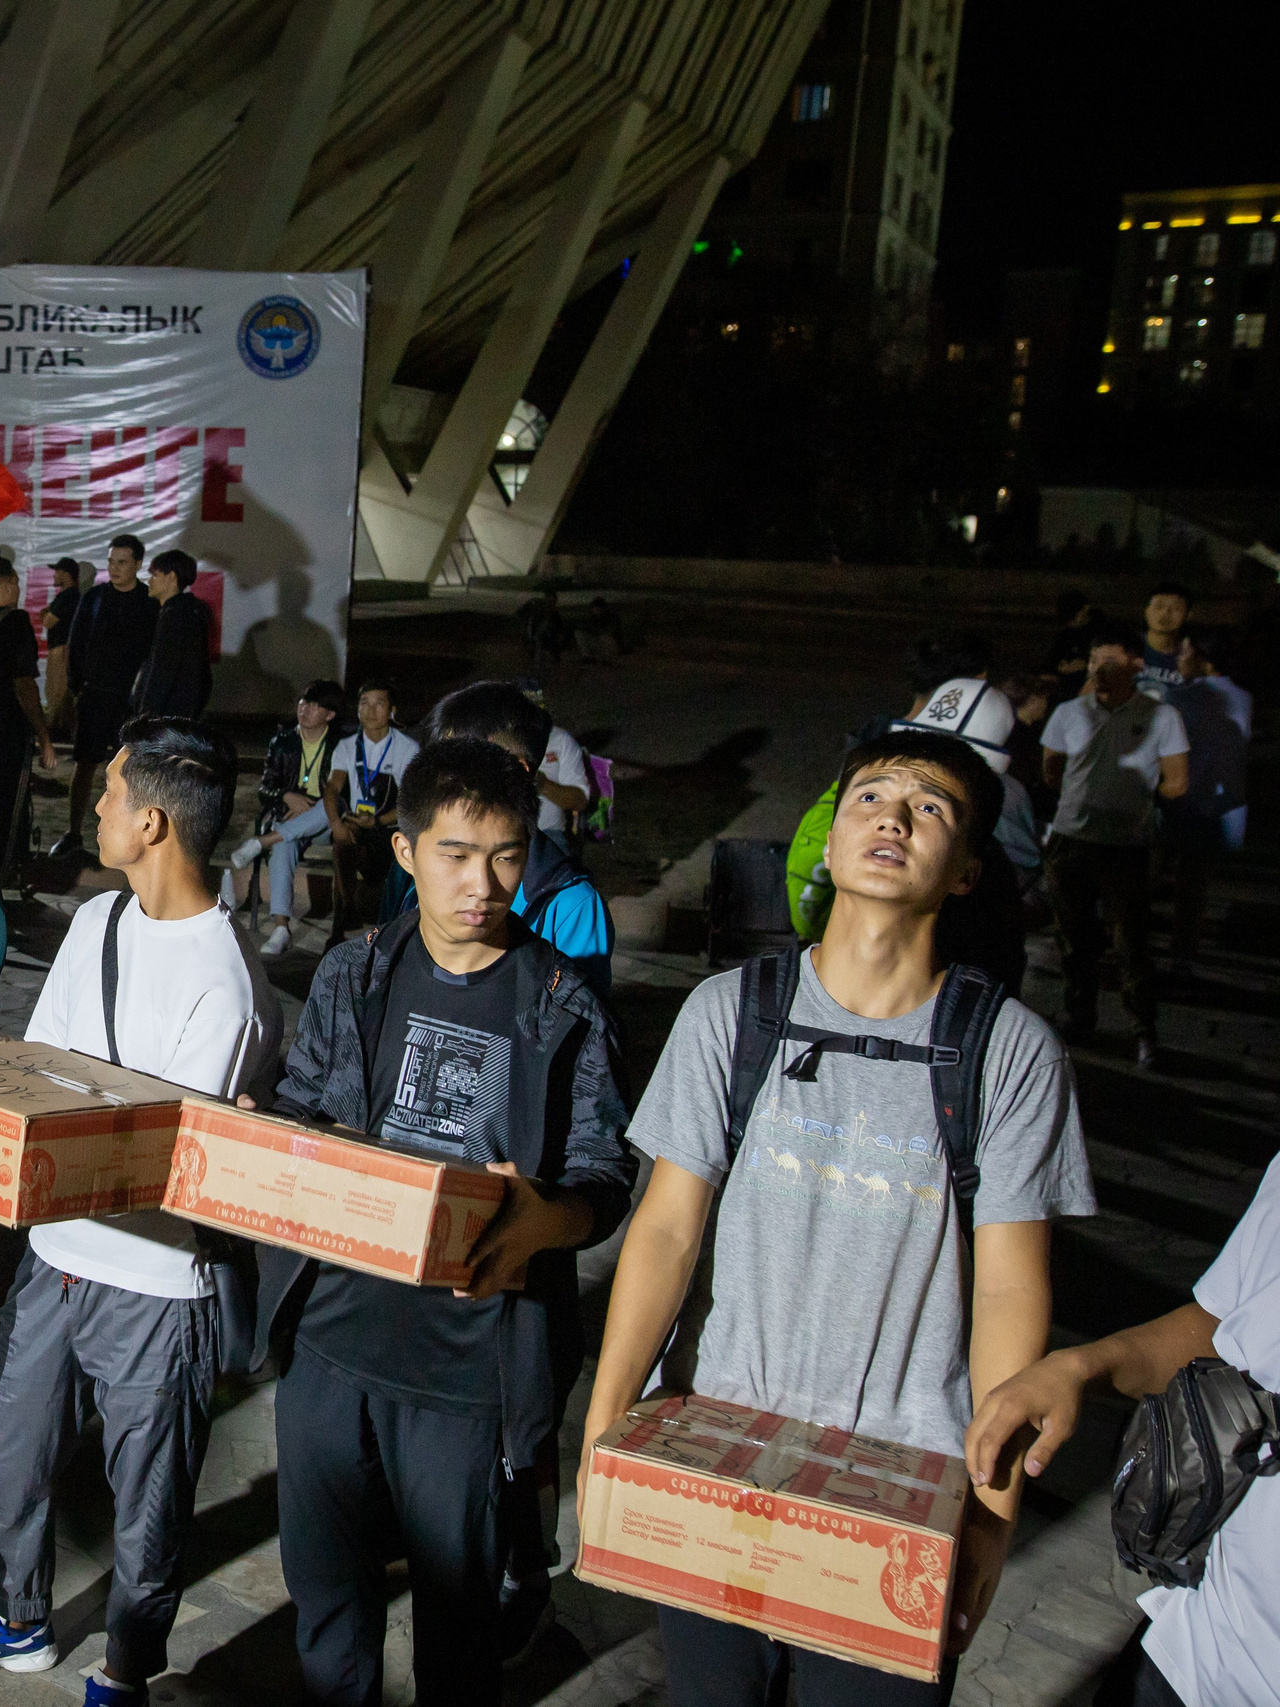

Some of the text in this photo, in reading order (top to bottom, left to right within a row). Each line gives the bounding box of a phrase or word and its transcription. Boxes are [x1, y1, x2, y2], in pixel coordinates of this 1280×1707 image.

[215, 1206, 352, 1253] СДЕЛАНО СО ВКУСОМ!
[377, 1215, 393, 1225] Срок
[669, 1475, 862, 1537] СДЕЛАНО СО ВКУСОМ!
[624, 1507, 686, 1531] Срок хранения:
[695, 1536, 743, 1556] 12 месяцев
[820, 1567, 860, 1586] 30 пачек
